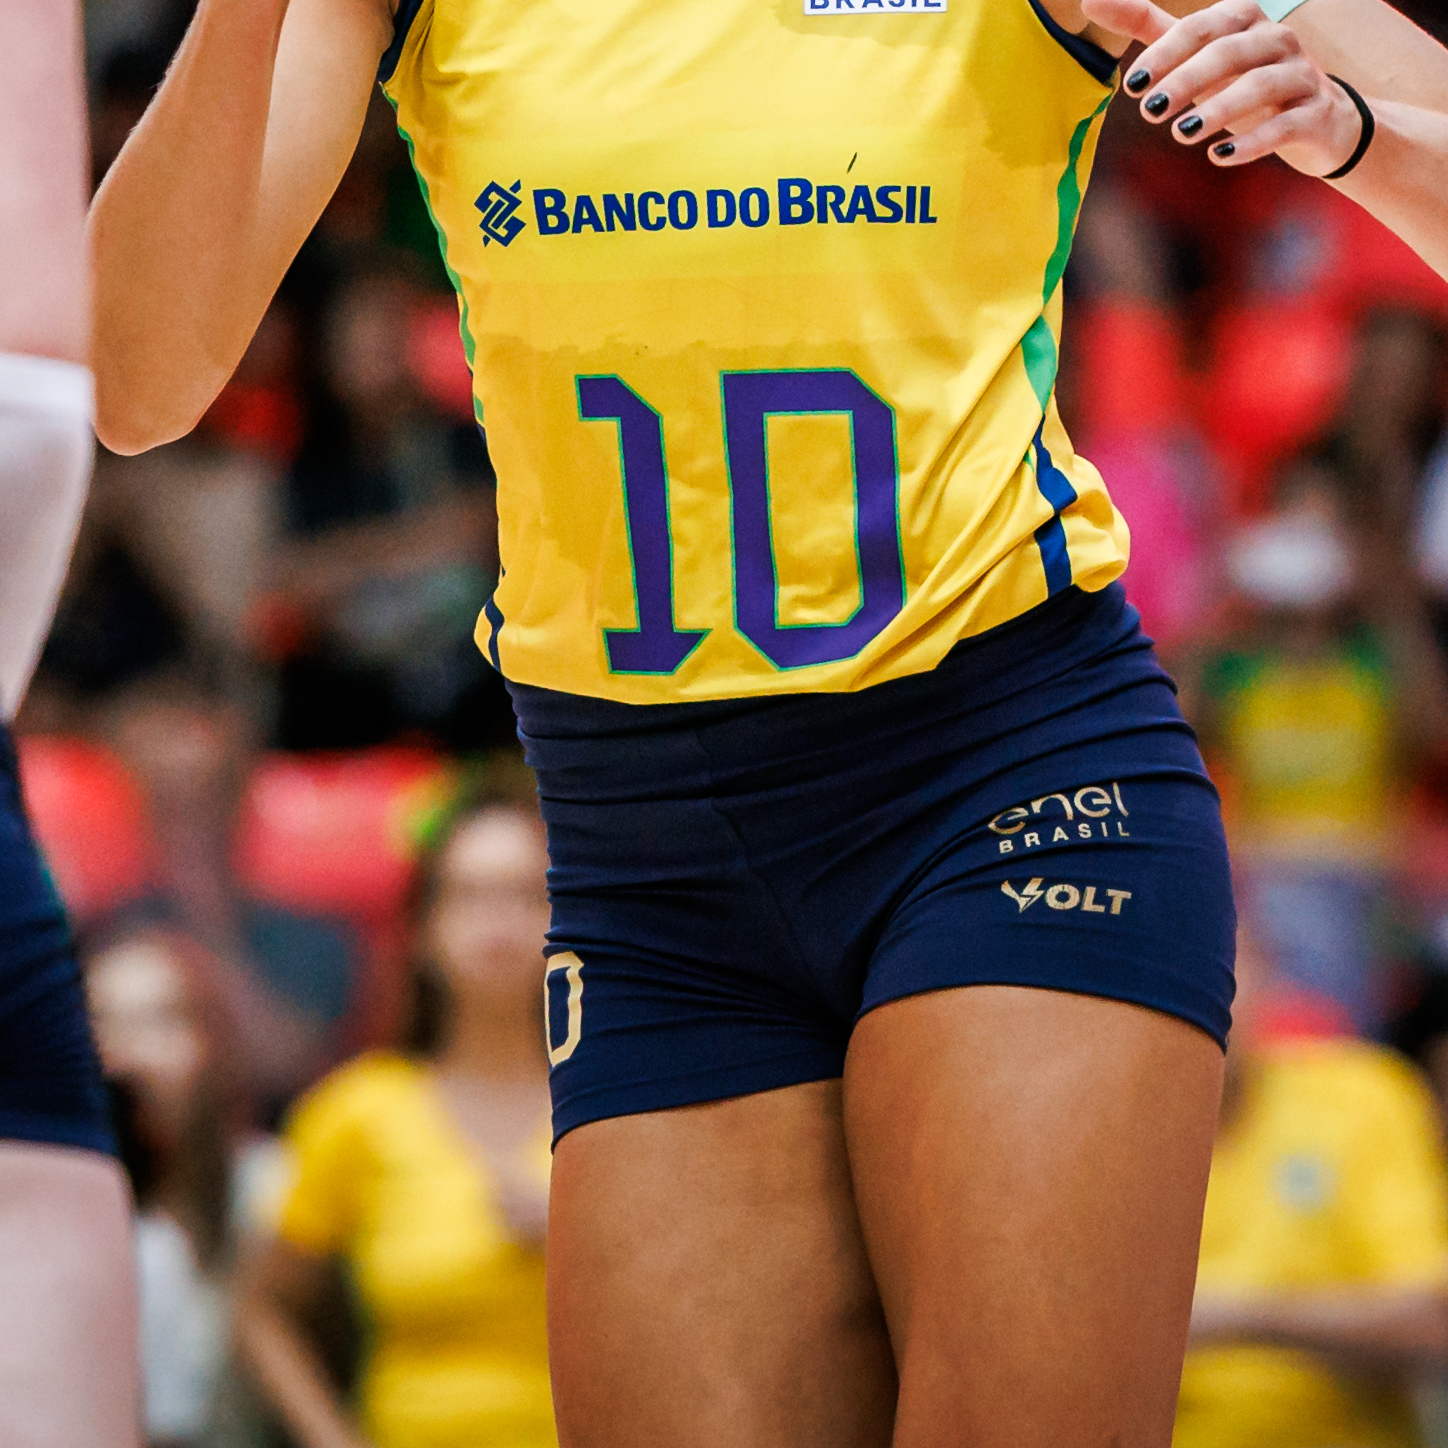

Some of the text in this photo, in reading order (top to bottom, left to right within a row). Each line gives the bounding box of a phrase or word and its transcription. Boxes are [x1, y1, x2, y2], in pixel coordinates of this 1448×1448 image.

[532, 178, 938, 236] BANCO DO BRASIL
[575, 368, 906, 675] 10
[988, 781, 1129, 834] enel
[999, 821, 1130, 853] BRASIL
[1001, 877, 1132, 913] VOLT
